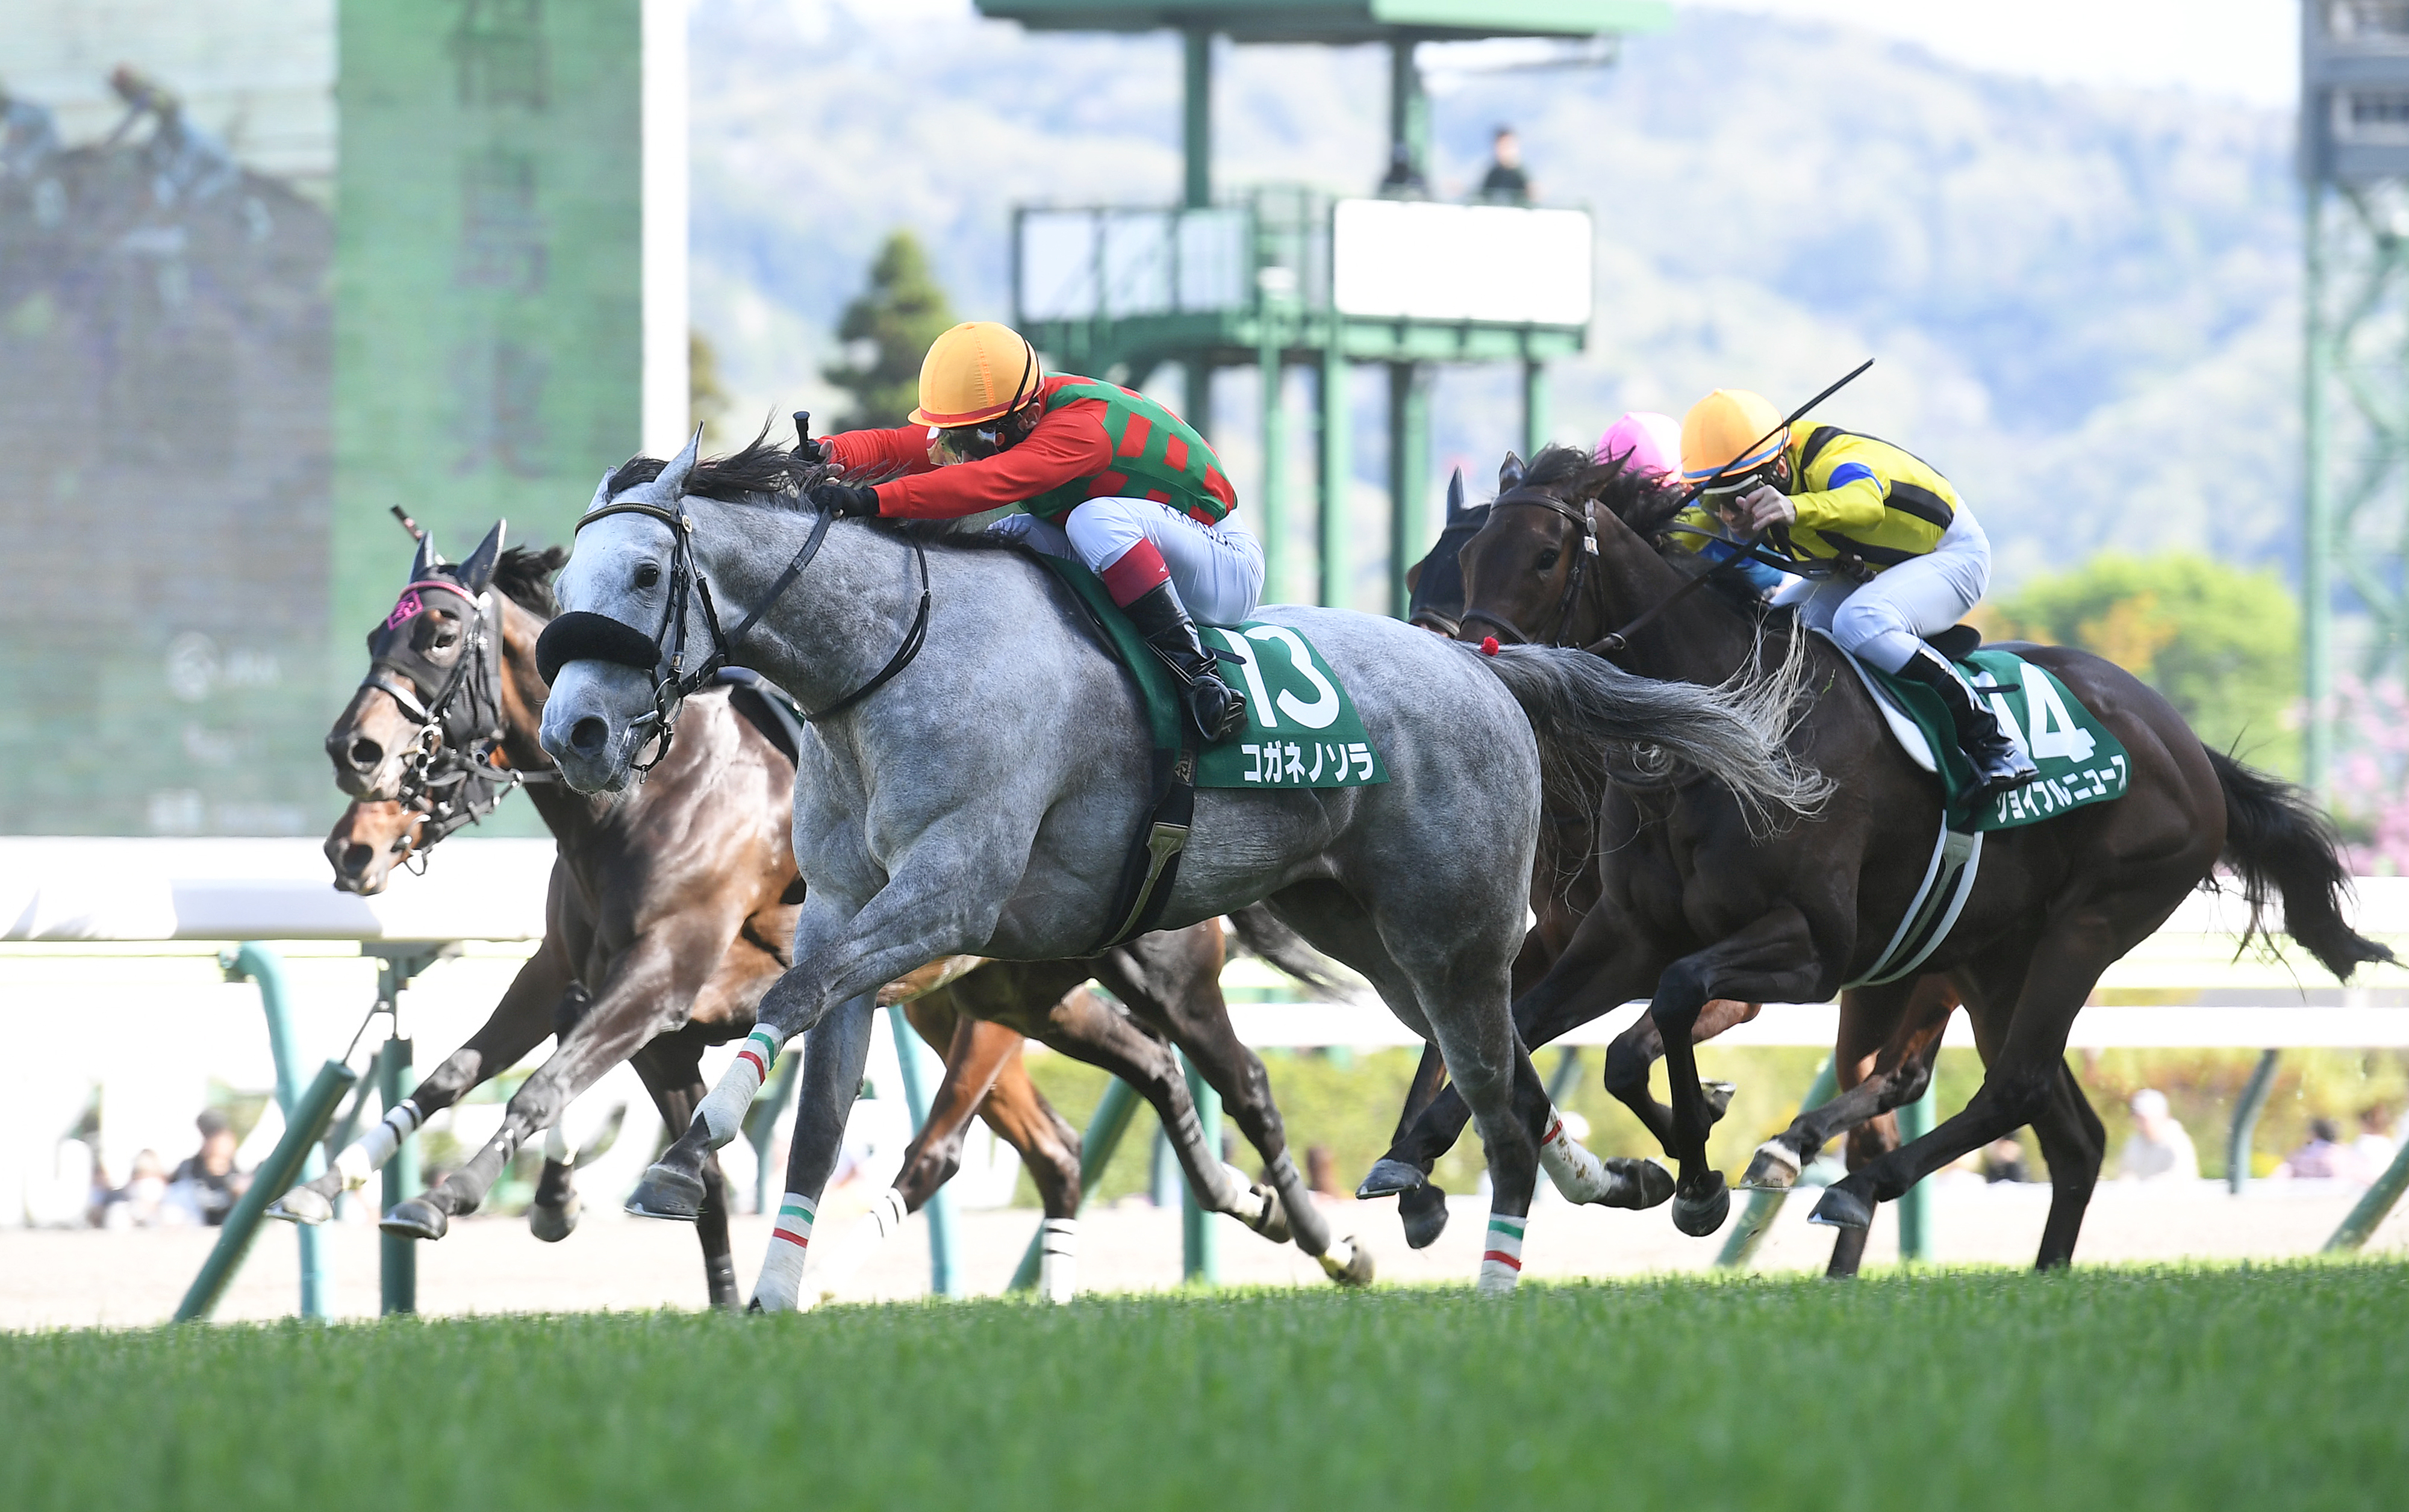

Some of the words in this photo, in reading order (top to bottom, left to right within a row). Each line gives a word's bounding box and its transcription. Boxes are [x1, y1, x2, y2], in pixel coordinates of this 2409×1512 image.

[1212, 625, 1340, 729] 13
[1241, 741, 1374, 783] コガネノソラ
